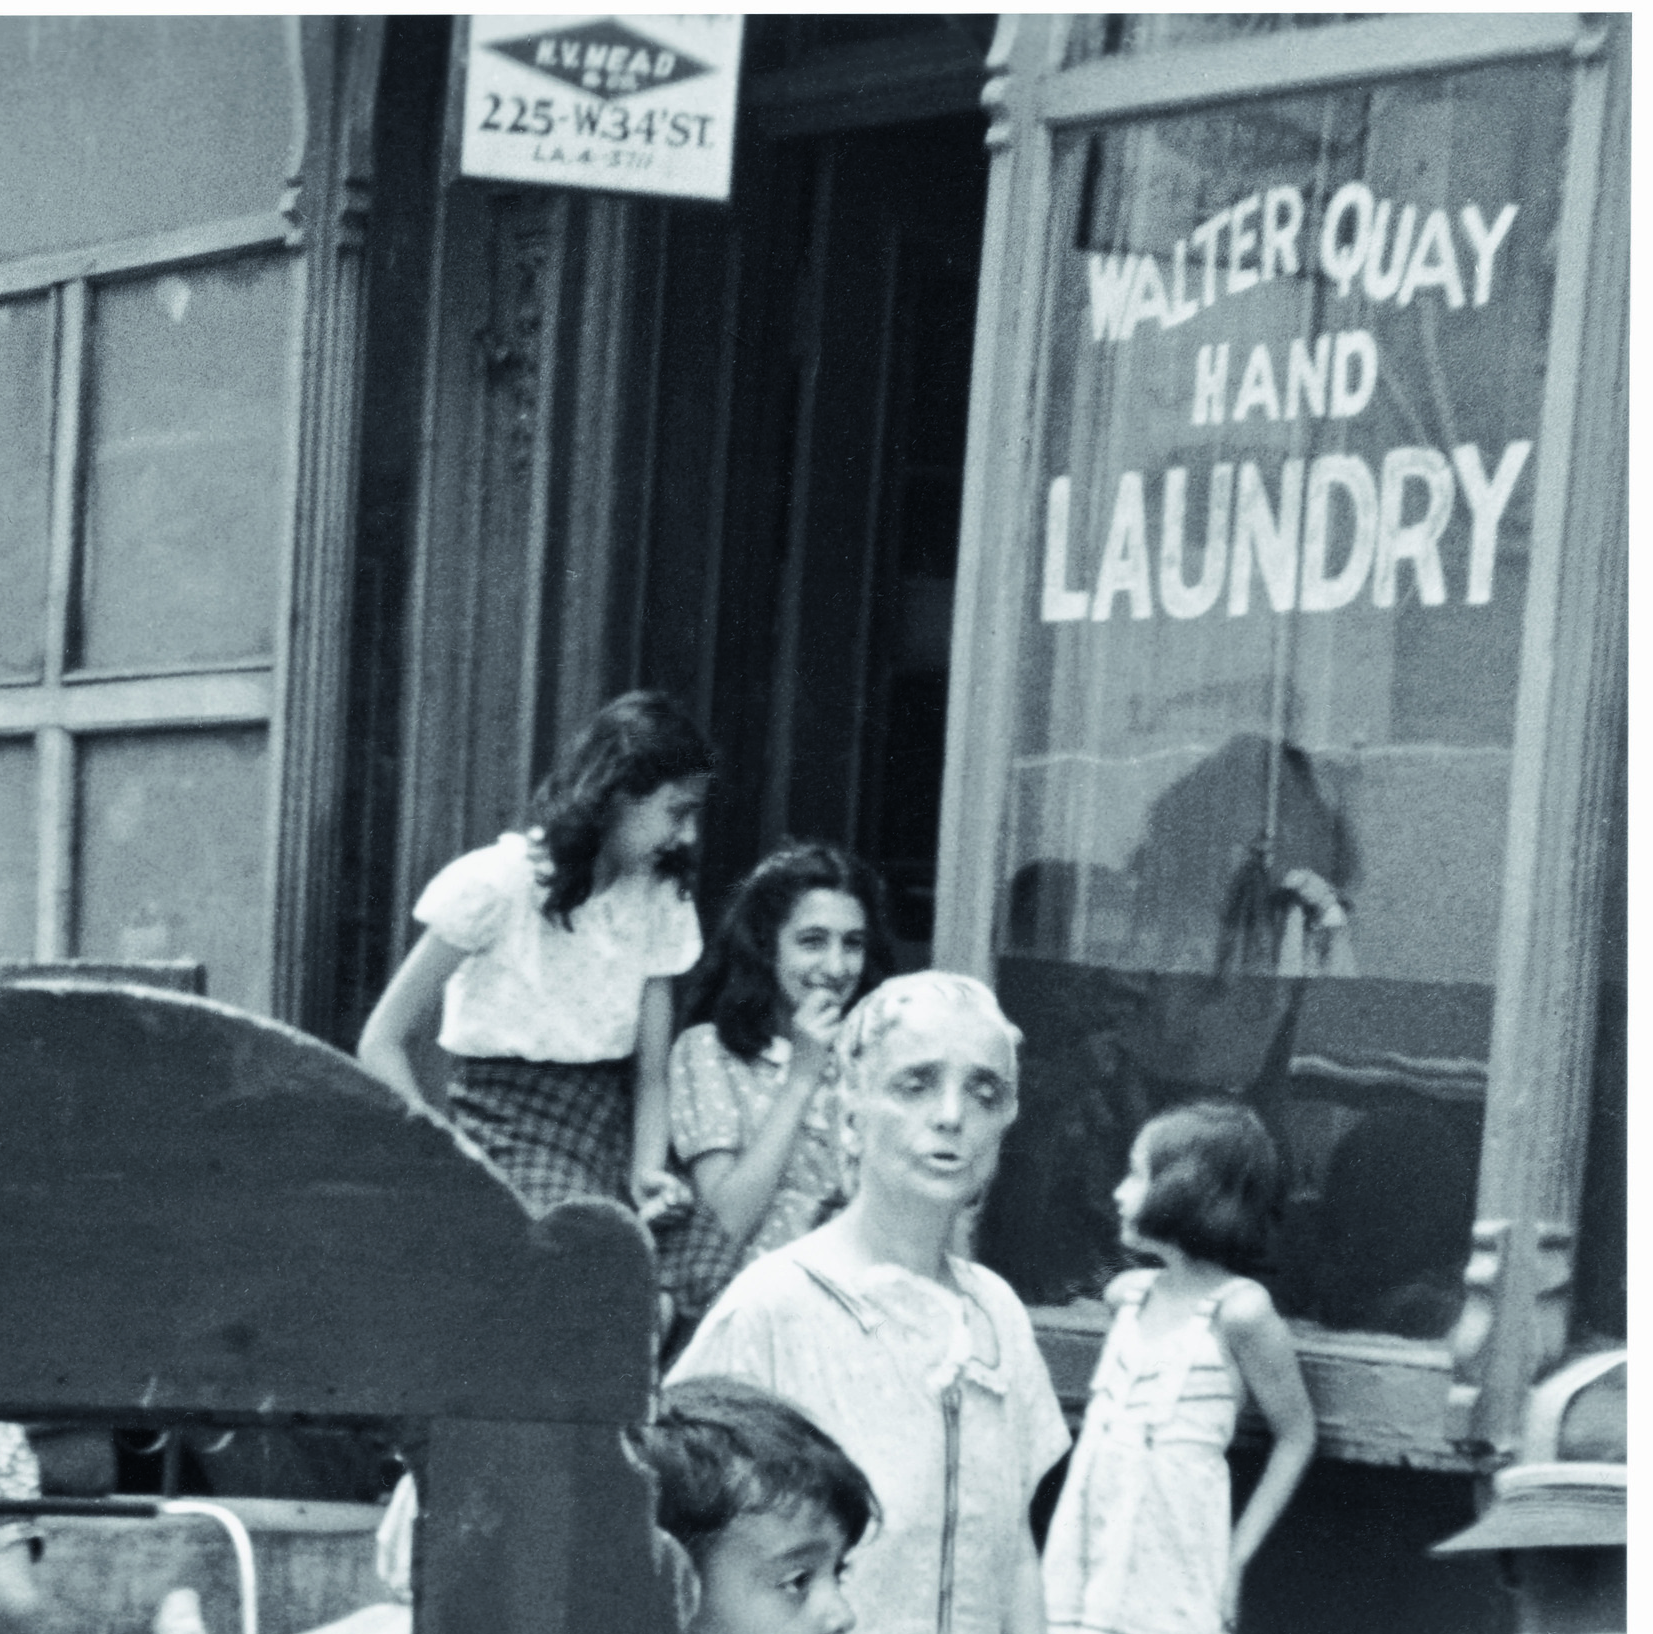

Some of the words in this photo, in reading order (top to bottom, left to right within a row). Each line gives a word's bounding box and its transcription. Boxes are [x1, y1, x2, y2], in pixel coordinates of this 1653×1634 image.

[1088, 184, 1305, 341] WALTER
[1319, 180, 1522, 309] QUAY
[1189, 328, 1379, 427] HAND
[1039, 438, 1535, 623] LAUNDRY
